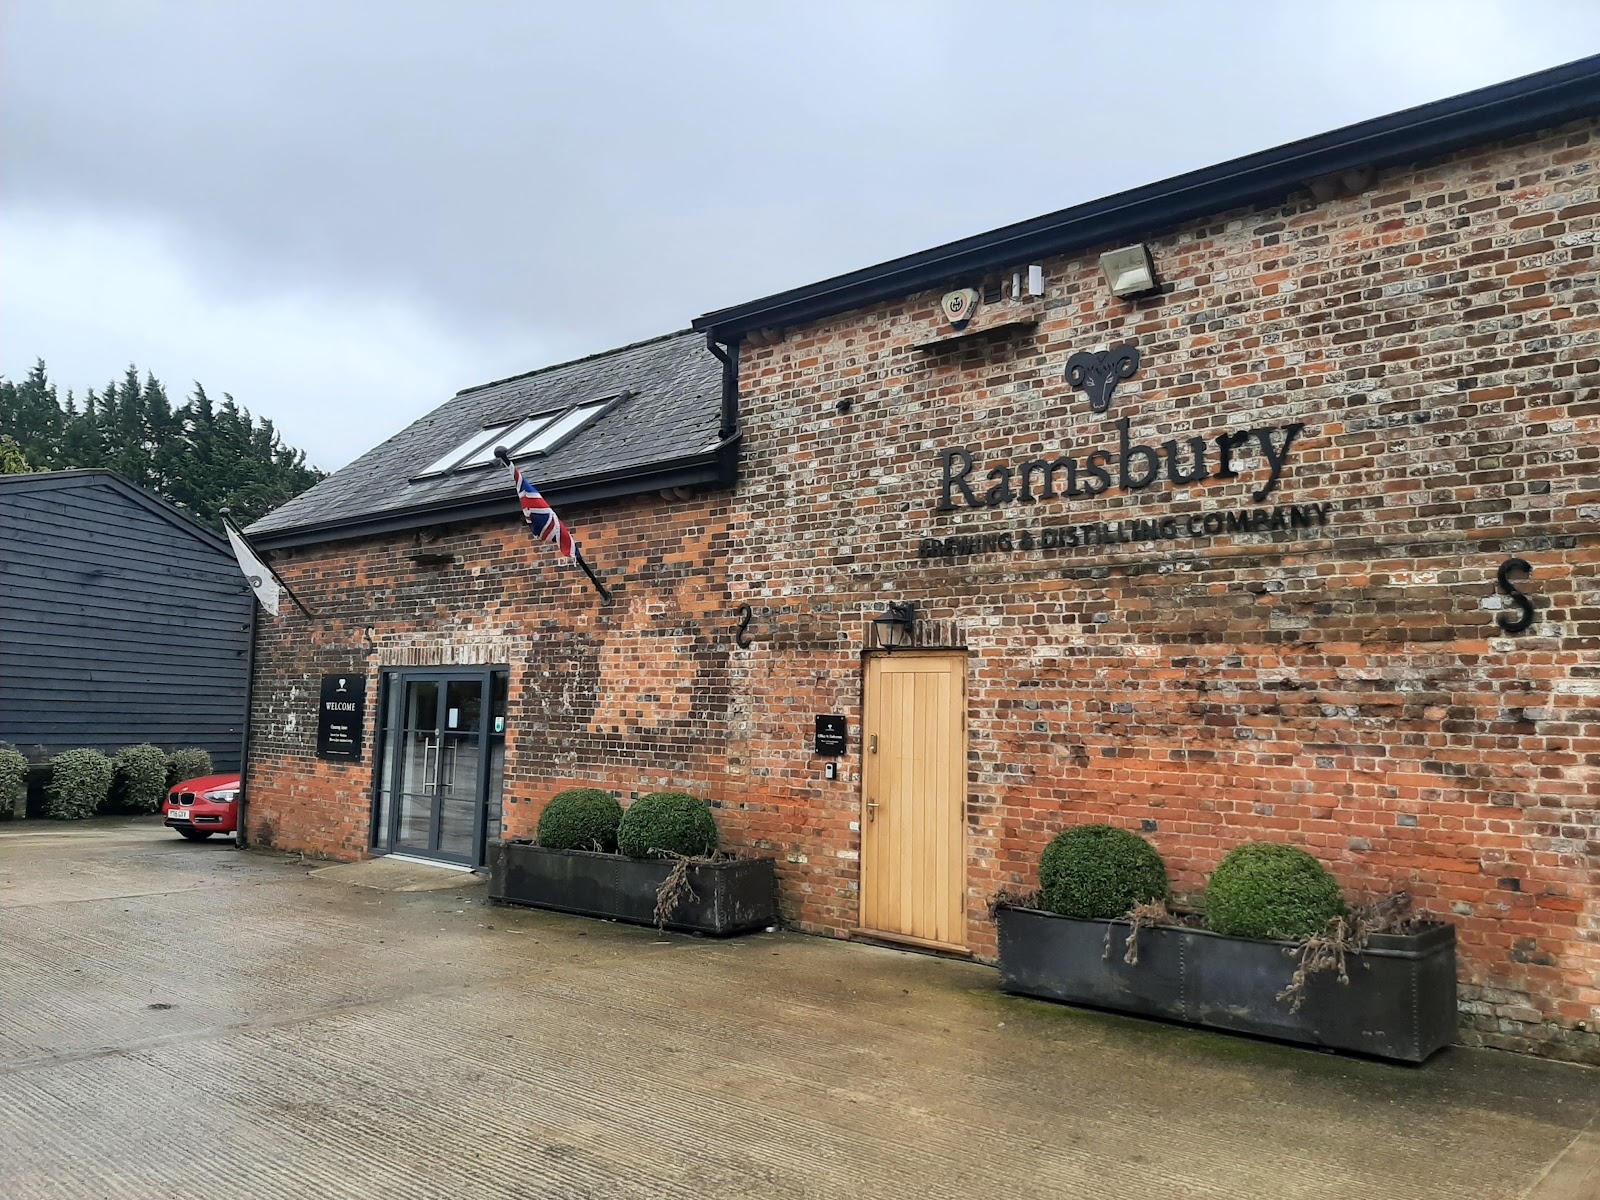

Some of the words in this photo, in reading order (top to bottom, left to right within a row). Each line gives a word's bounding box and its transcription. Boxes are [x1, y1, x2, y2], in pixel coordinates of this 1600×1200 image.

[936, 416, 1305, 511] Ramsbury
[919, 532, 1013, 558] BREWING
[1040, 516, 1177, 549] DISTILLING
[1187, 502, 1332, 537] COMPANY
[325, 701, 356, 711] WELCOME
